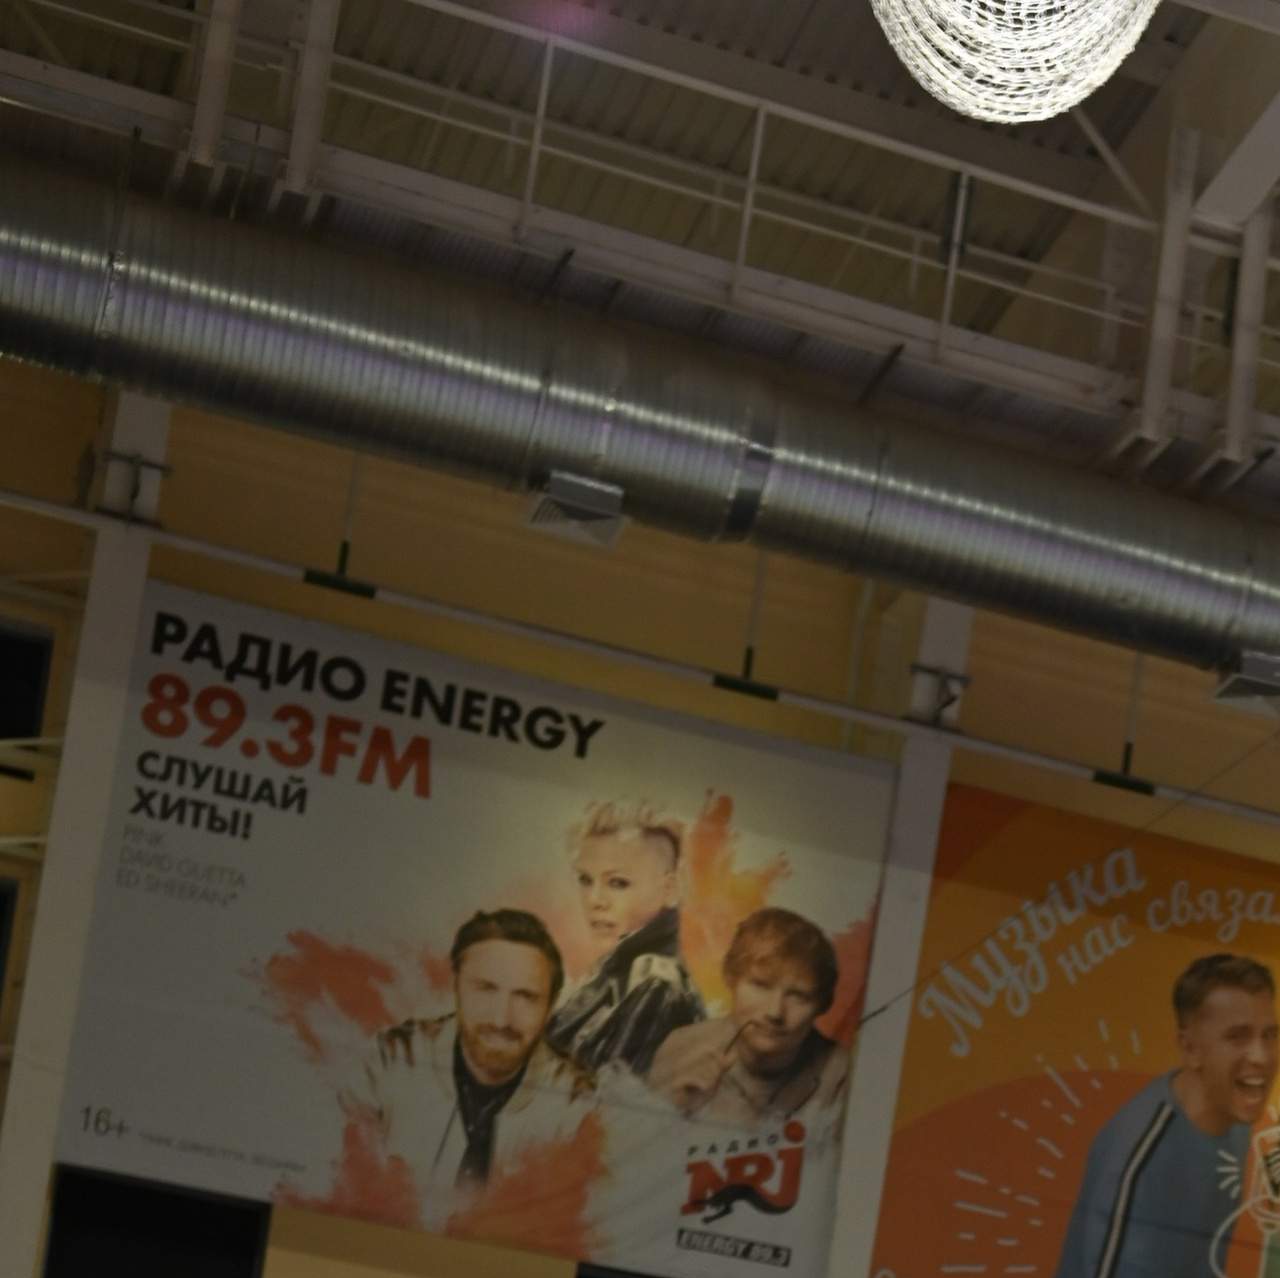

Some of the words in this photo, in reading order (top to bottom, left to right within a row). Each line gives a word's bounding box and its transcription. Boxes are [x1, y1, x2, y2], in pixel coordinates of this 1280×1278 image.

[150, 611, 367, 702] РАДИО
[380, 668, 606, 760] ENERGY
[141, 672, 433, 799] 89.3FM
[129, 785, 253, 840] ХИТЫ!
[136, 749, 309, 815] СЛУШАЙ
[918, 847, 1148, 1058] Музыка
[1057, 912, 1136, 985] нас
[80, 1106, 129, 1139] 16+
